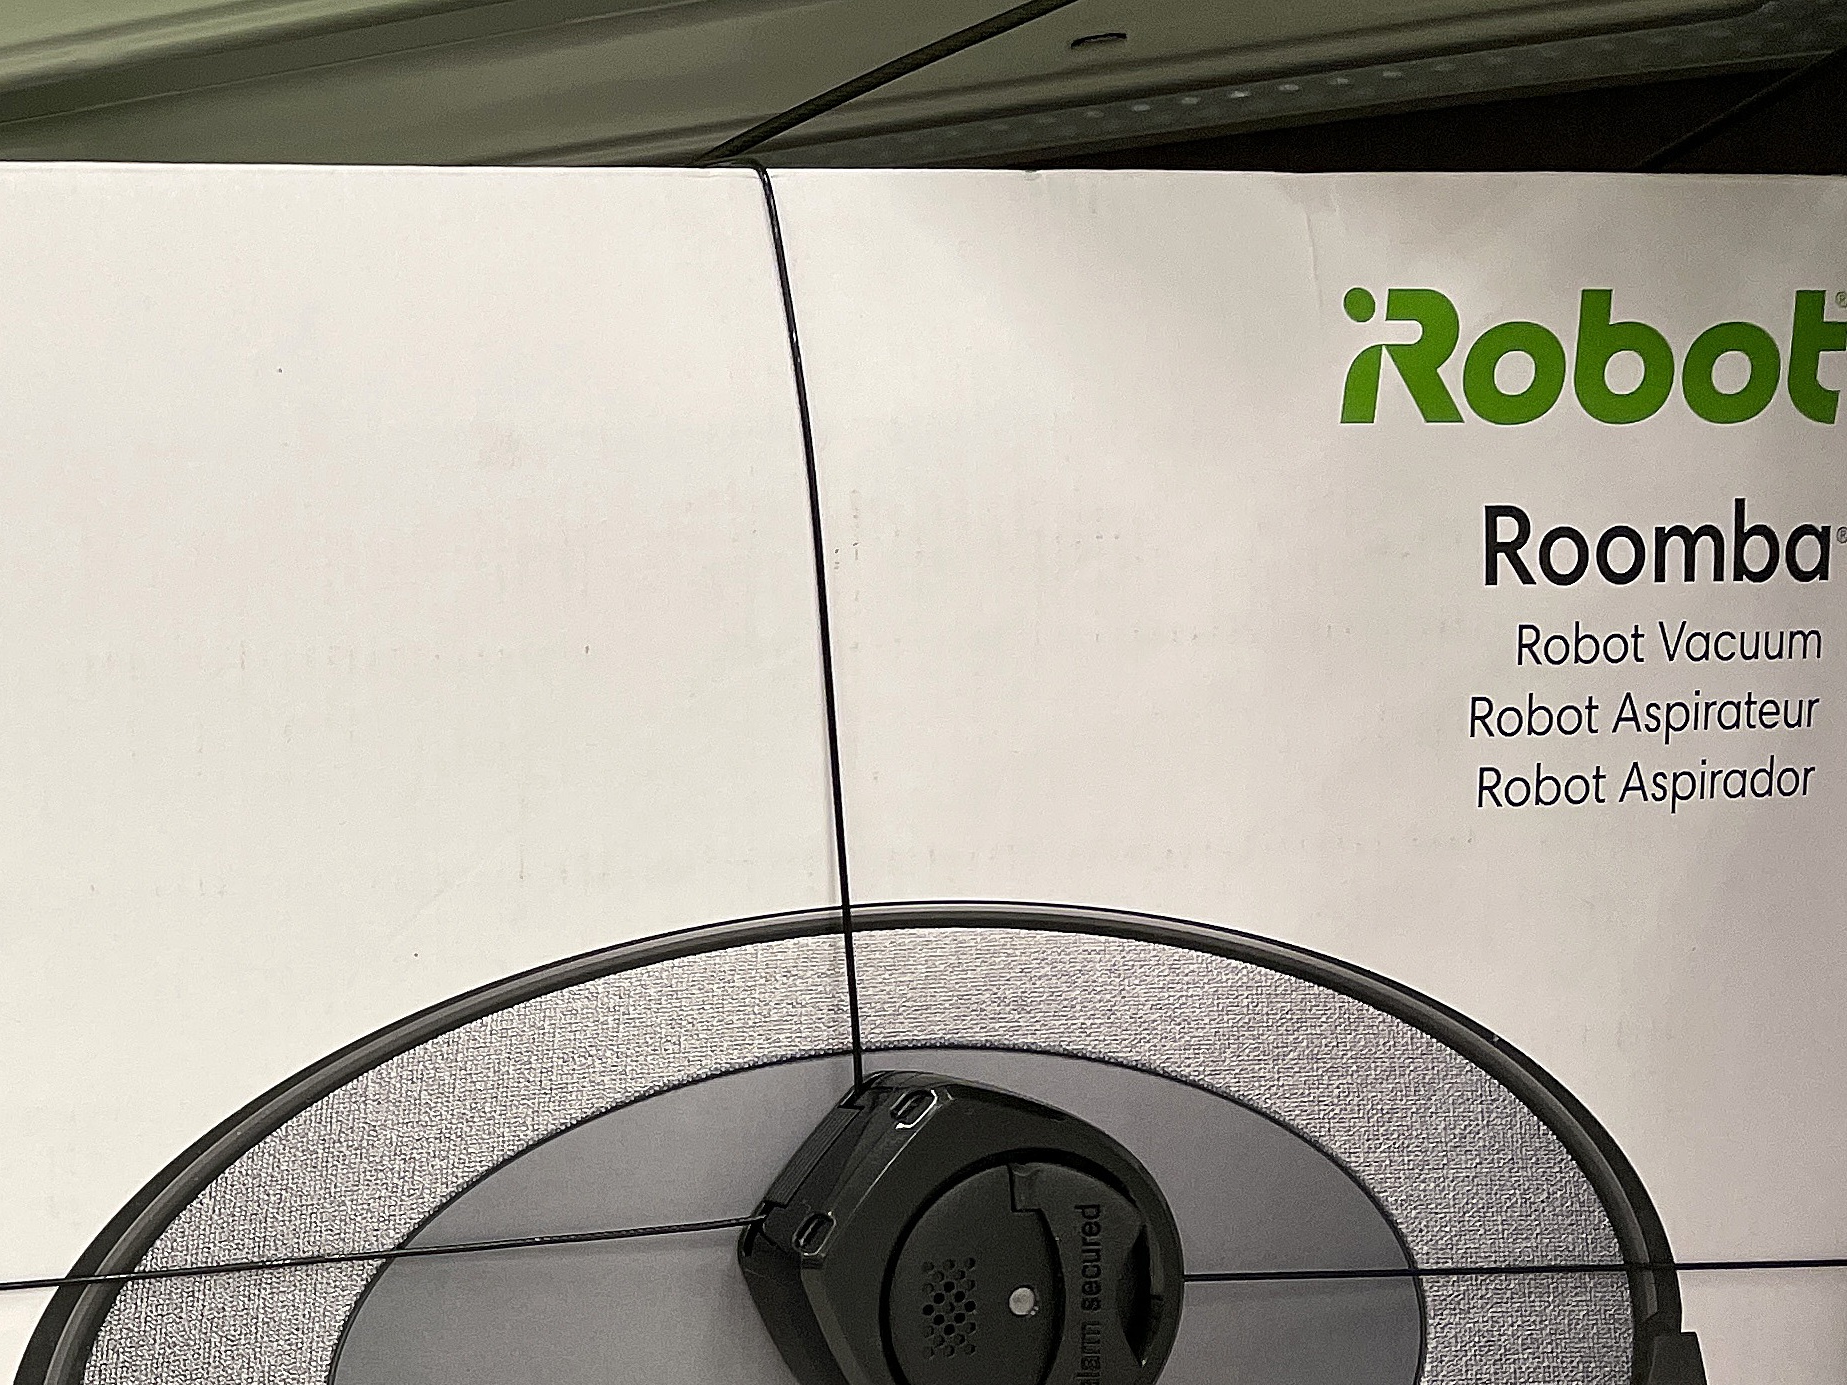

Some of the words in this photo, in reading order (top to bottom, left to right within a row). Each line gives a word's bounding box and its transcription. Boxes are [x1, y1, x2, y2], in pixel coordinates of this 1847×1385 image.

[1340, 287, 1847, 426] iRobot
[1484, 497, 1832, 587] Roomba
[1517, 621, 1645, 666] Robot
[1658, 620, 1822, 662] Vacuum
[1469, 693, 1599, 738] Robot
[1612, 690, 1820, 745] Aspirateur
[1477, 762, 1606, 808] Robot
[1619, 755, 1816, 814] Aspirador
[1074, 1203, 1102, 1313] secured
